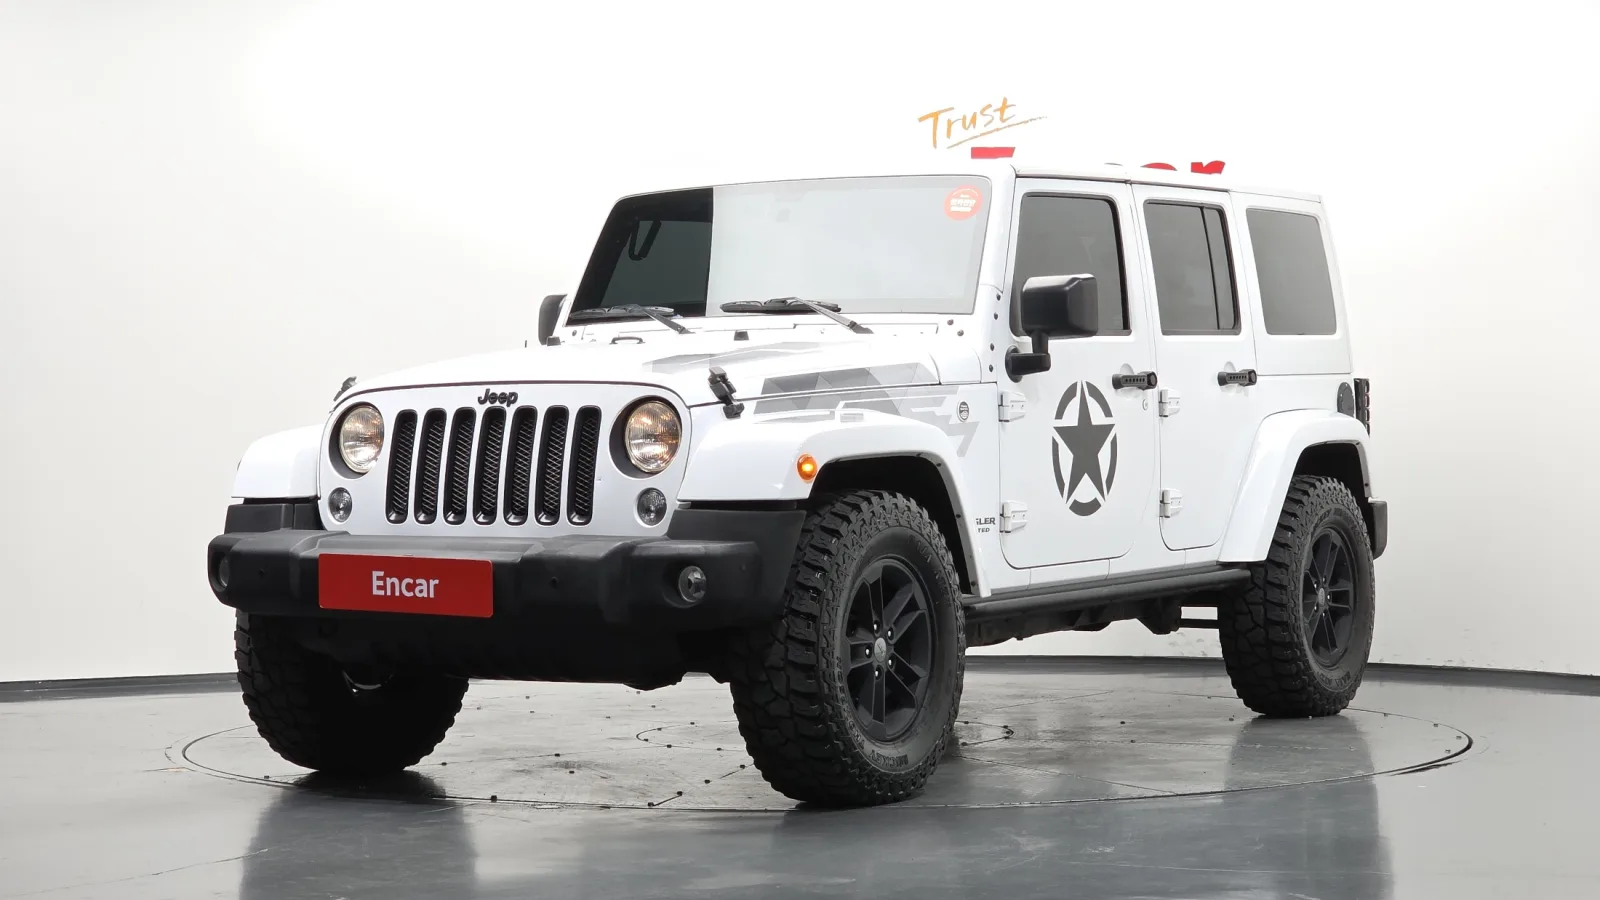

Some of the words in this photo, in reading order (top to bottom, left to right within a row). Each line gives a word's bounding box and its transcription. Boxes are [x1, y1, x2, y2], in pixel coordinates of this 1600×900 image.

[918, 97, 1016, 149] Trust
[477, 388, 518, 407] Jeep
[372, 570, 440, 598] Encar
